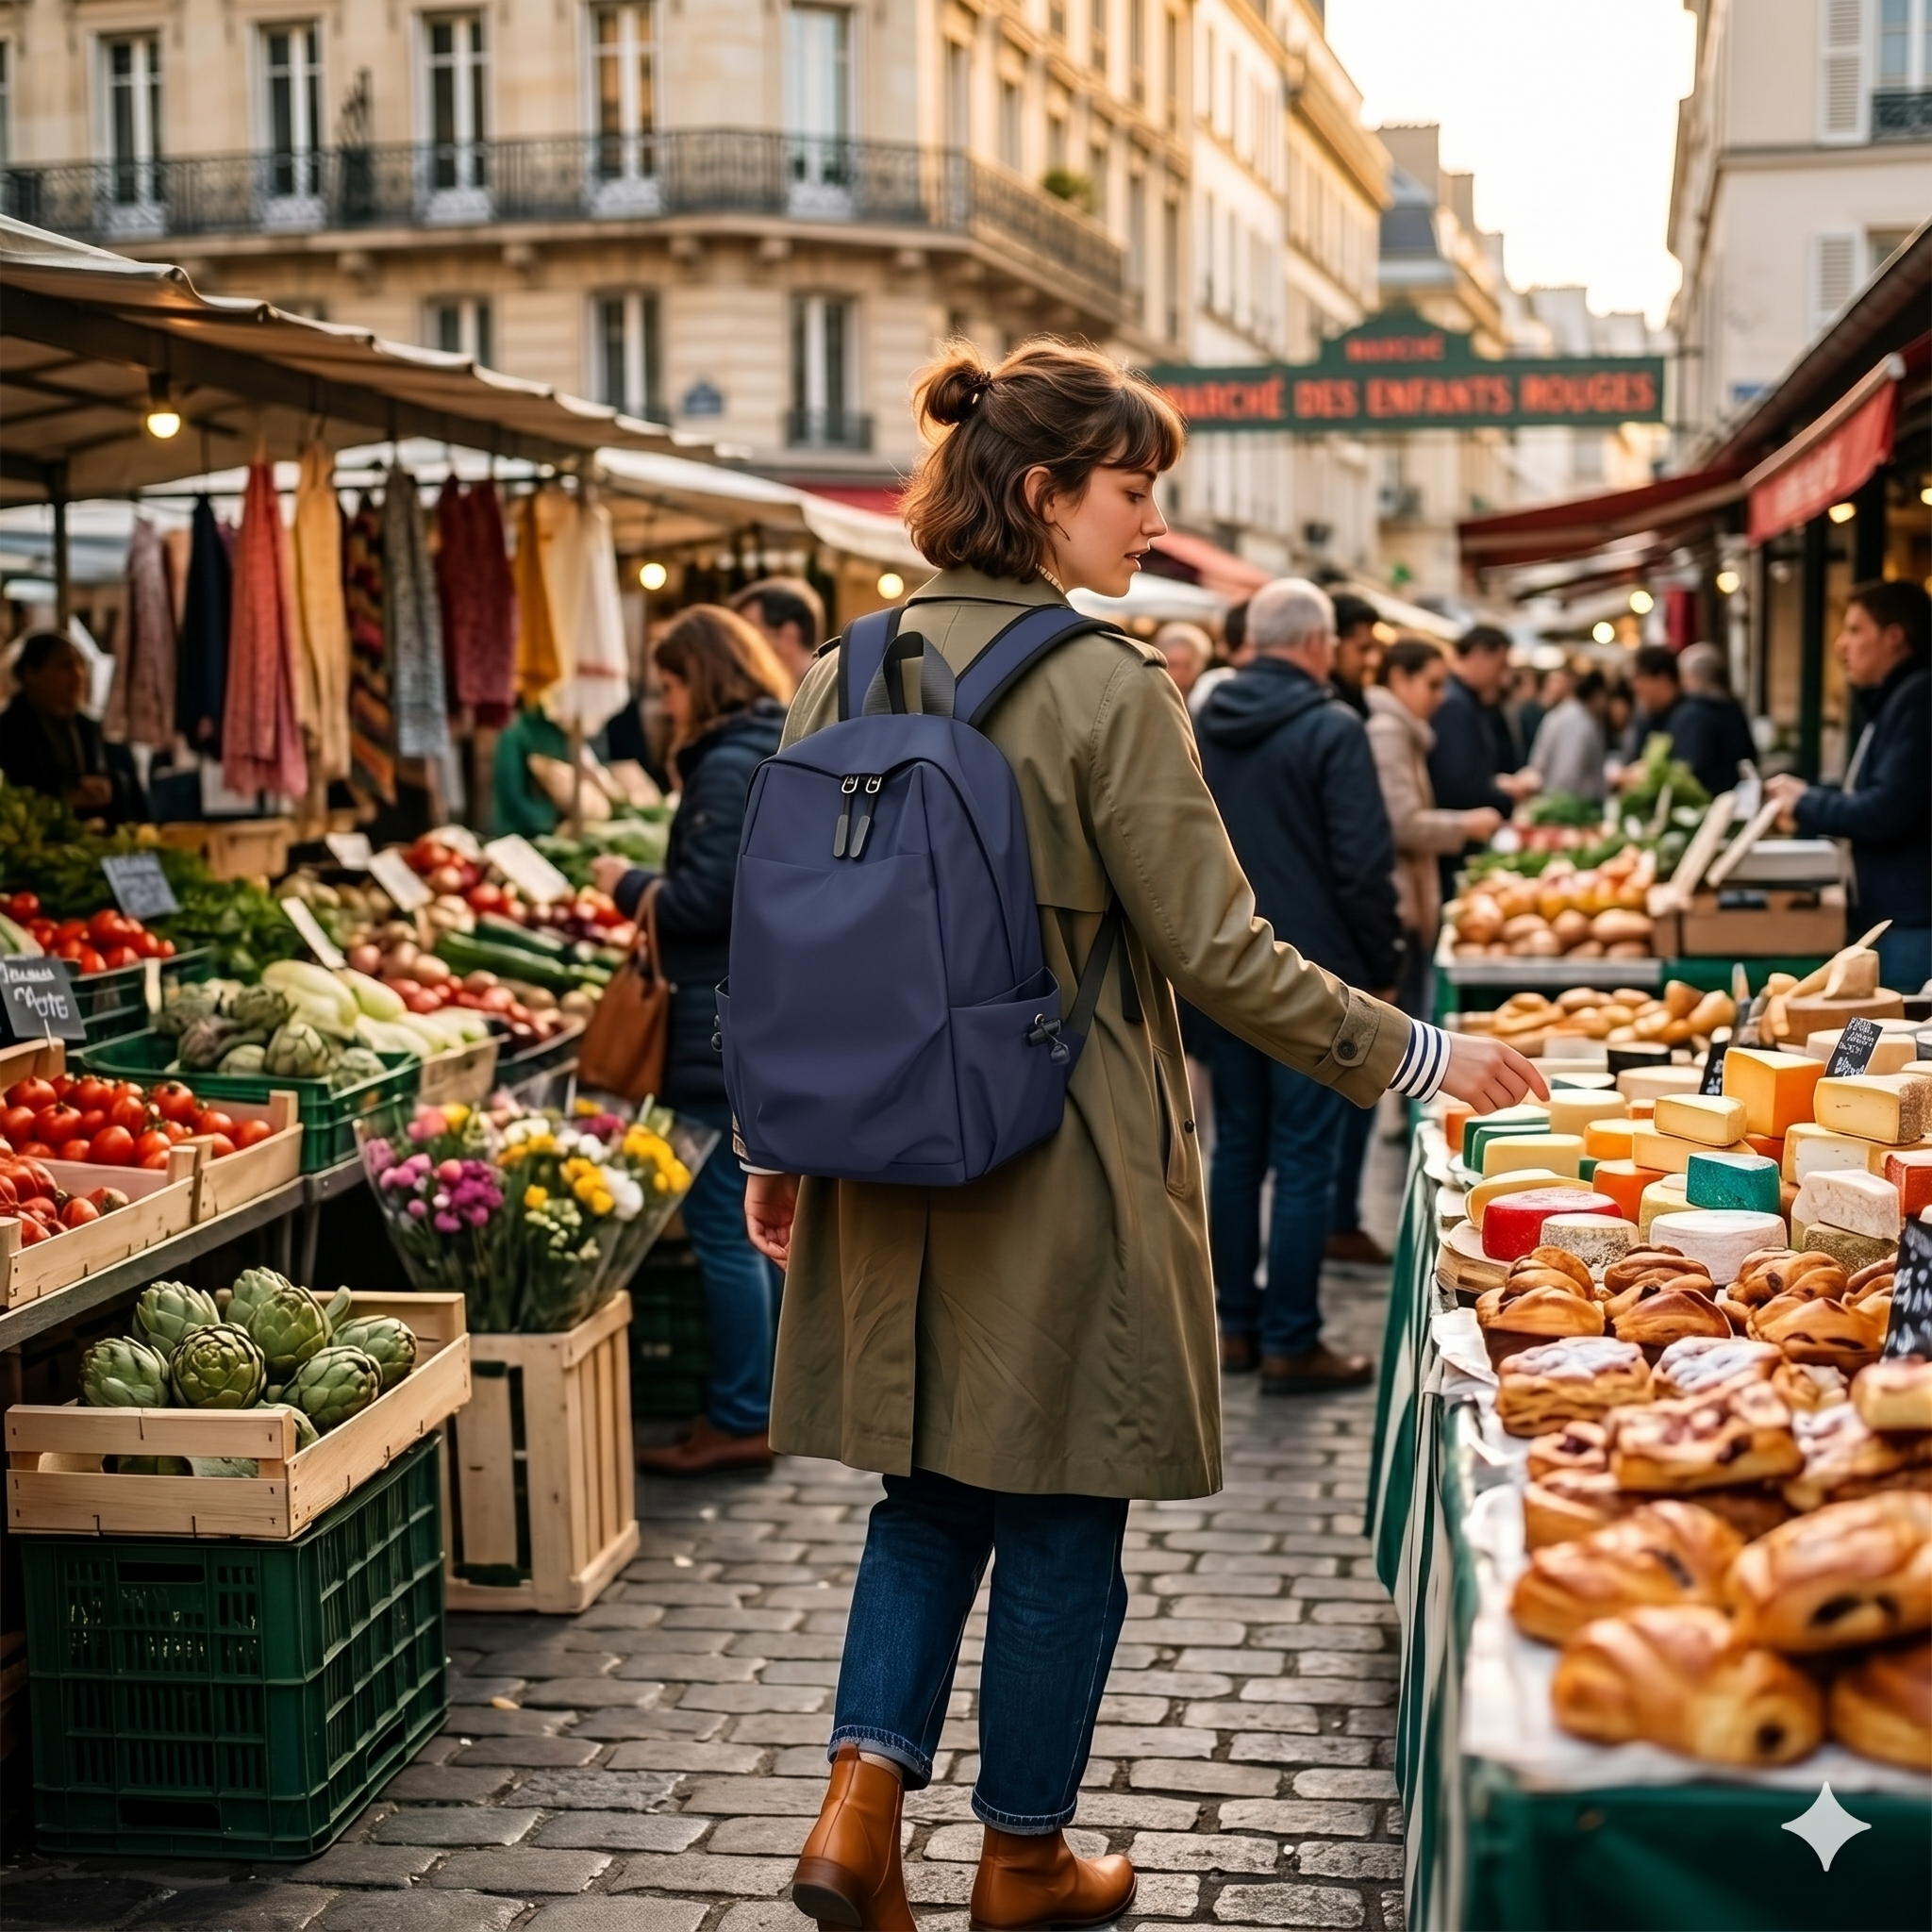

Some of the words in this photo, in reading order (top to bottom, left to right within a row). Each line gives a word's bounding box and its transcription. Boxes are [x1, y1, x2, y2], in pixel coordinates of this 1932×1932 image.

[1294, 379, 1358, 417] DES
[1365, 375, 1513, 417] ENFANTS
[1521, 373, 1655, 412] ROUGES
